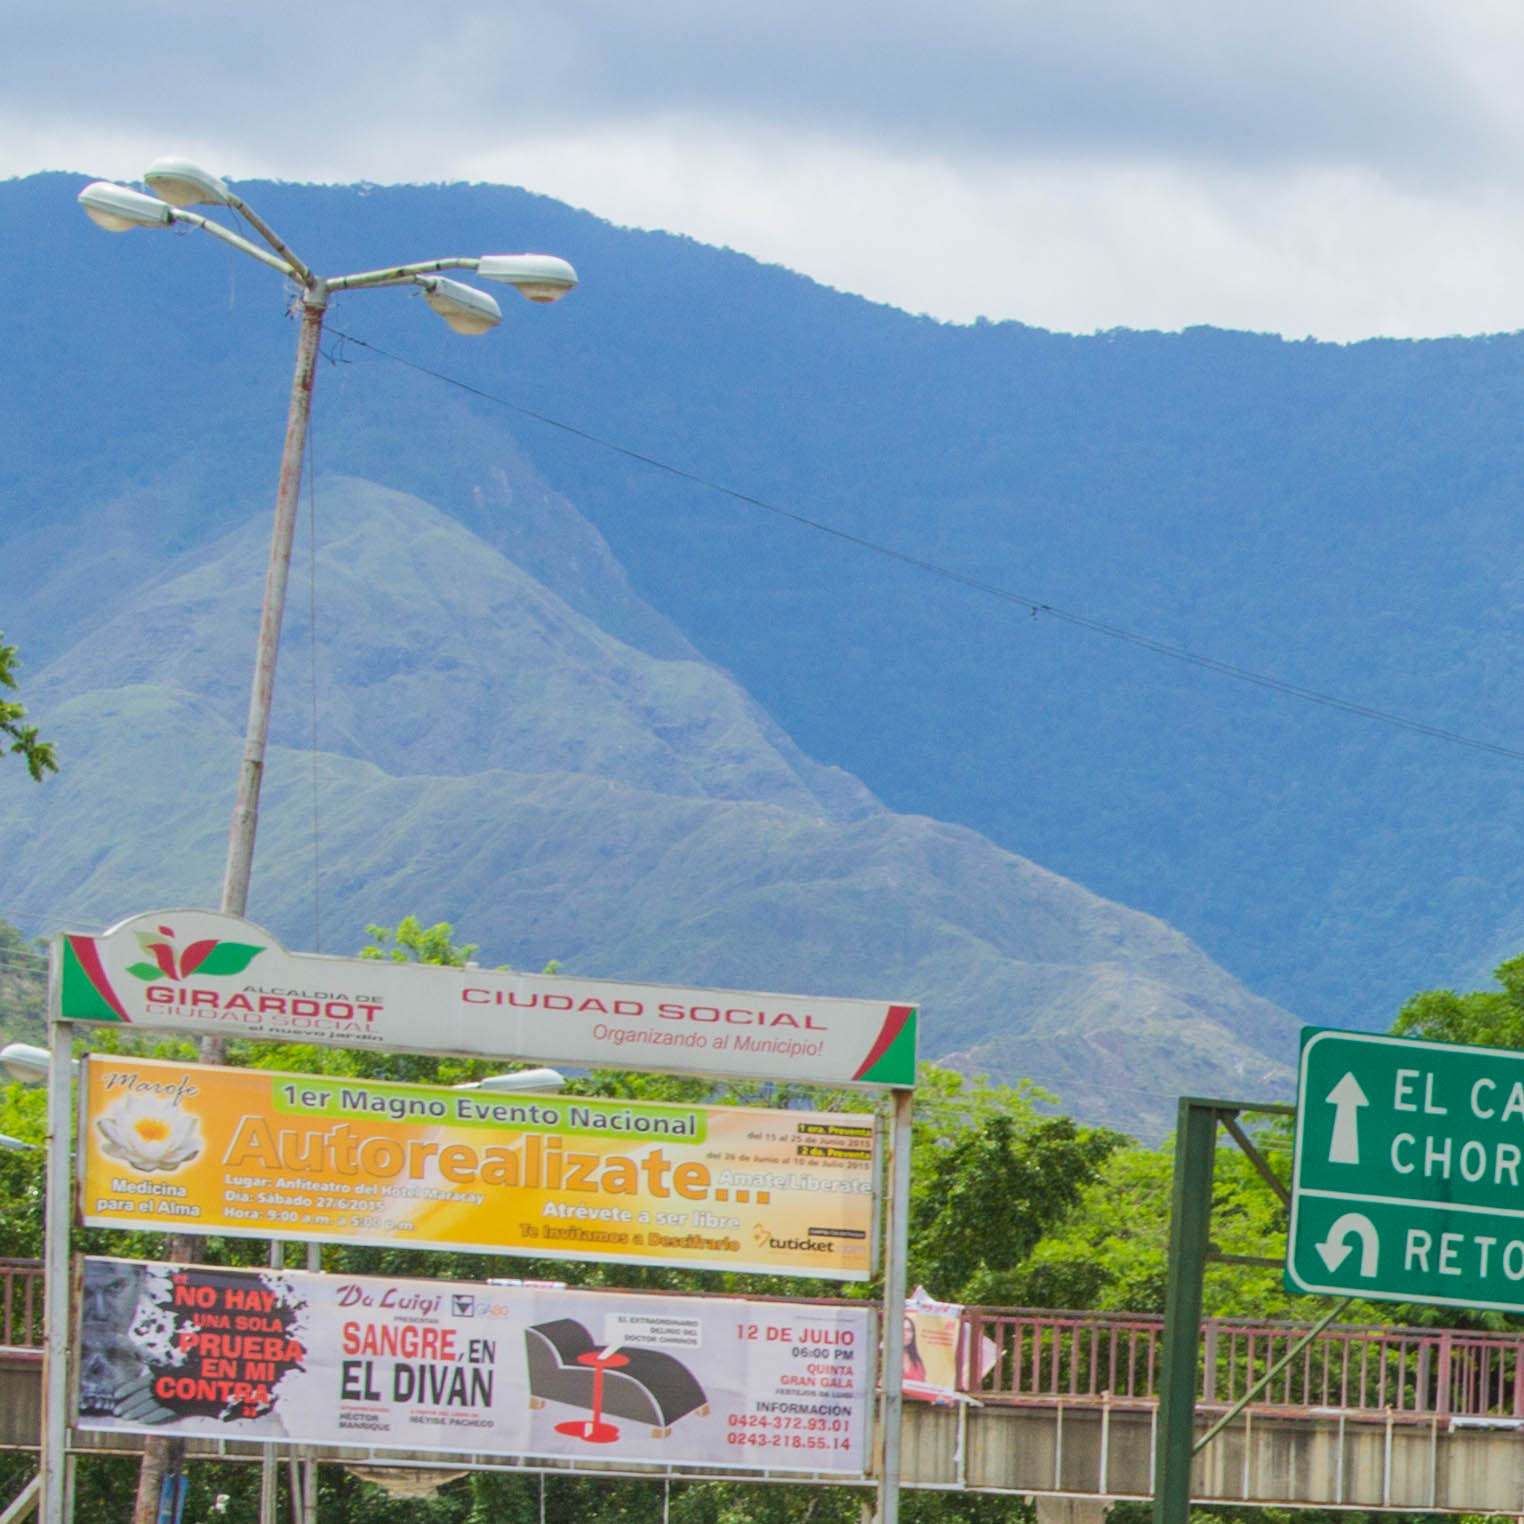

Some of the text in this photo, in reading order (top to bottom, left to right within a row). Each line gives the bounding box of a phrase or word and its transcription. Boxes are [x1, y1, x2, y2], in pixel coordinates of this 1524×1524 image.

[146, 986, 384, 1022] GIRARDOT
[355, 995, 383, 1004] DE
[462, 988, 828, 1031] CIUDAD SOCIAL
[146, 1004, 380, 1032] CIUDAD SOCIAL
[593, 1024, 824, 1057] Organizando al Municipio!
[1393, 1068, 1449, 1116] EL
[284, 1085, 696, 1136] 1er Magno Evento Nacional
[112, 1179, 187, 1197] Medicina
[224, 1174, 485, 1206] Lugar: Anfiteatro del Hotel Maracay
[97, 1199, 201, 1217] para el Alma
[224, 1207, 265, 1220] Hora:
[337, 1217, 346, 1226] a
[637, 1211, 649, 1223] a
[656, 1212, 688, 1226] ser
[694, 1211, 741, 1231] libre
[520, 1223, 741, 1252] Te Invitamos a Descifrarlo
[175, 1286, 276, 1313] NO HAY
[336, 1284, 442, 1316] Da Luigi
[192, 1313, 283, 1333] UNA SOLA
[737, 1324, 855, 1346] 12 DE JULIO
[179, 1333, 304, 1362] PRUEBA
[342, 1321, 497, 1365] SANGRE, EN
[792, 1347, 854, 1360] 06:00 PM
[202, 1358, 276, 1382] EN MI
[341, 1360, 382, 1402] EL
[780, 1375, 854, 1389] GRAN GALA
[807, 1364, 854, 1376] QUINTA
[155, 1376, 270, 1405] CONTRA
[728, 1414, 850, 1433] 0424-372.93.01
[727, 1432, 850, 1451] 0243-218.55.14
